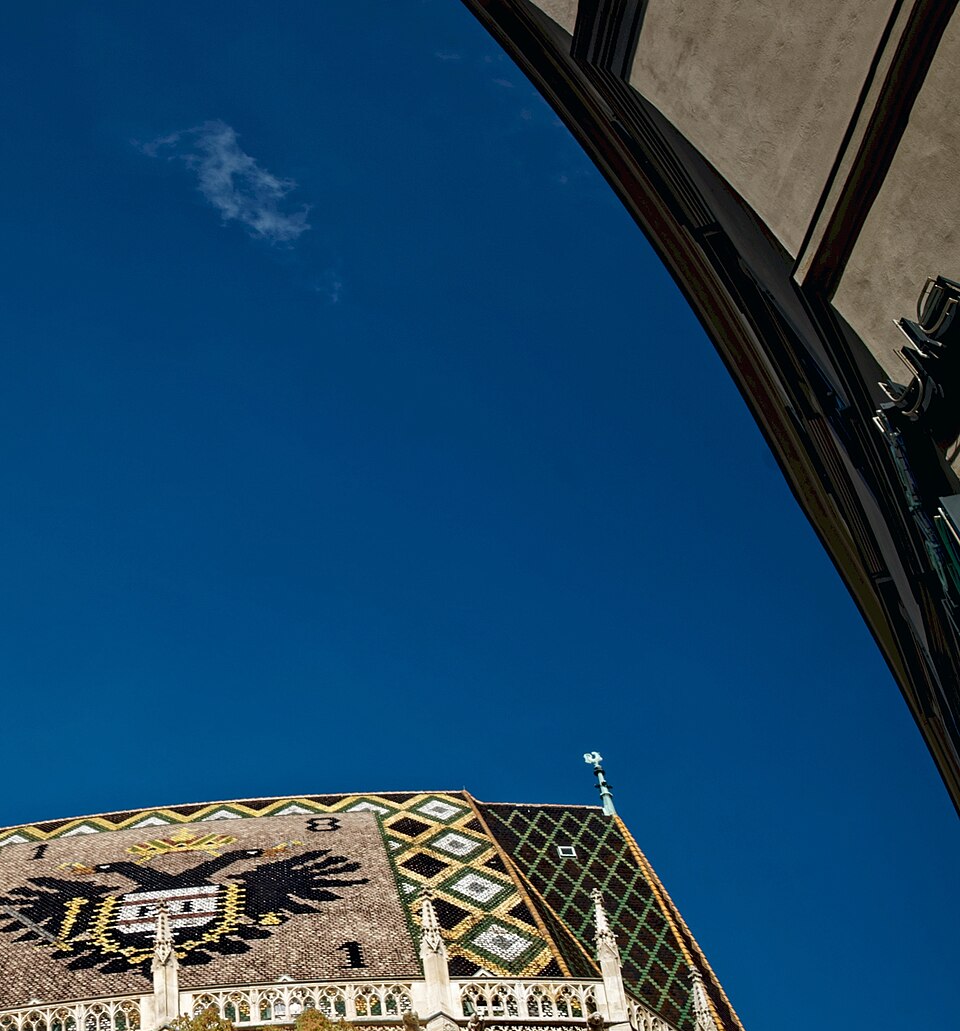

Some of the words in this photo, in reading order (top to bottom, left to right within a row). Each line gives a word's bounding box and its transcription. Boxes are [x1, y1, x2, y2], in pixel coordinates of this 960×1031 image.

[27, 844, 48, 861] 1
[305, 817, 343, 832] 8
[336, 941, 369, 968] 1
